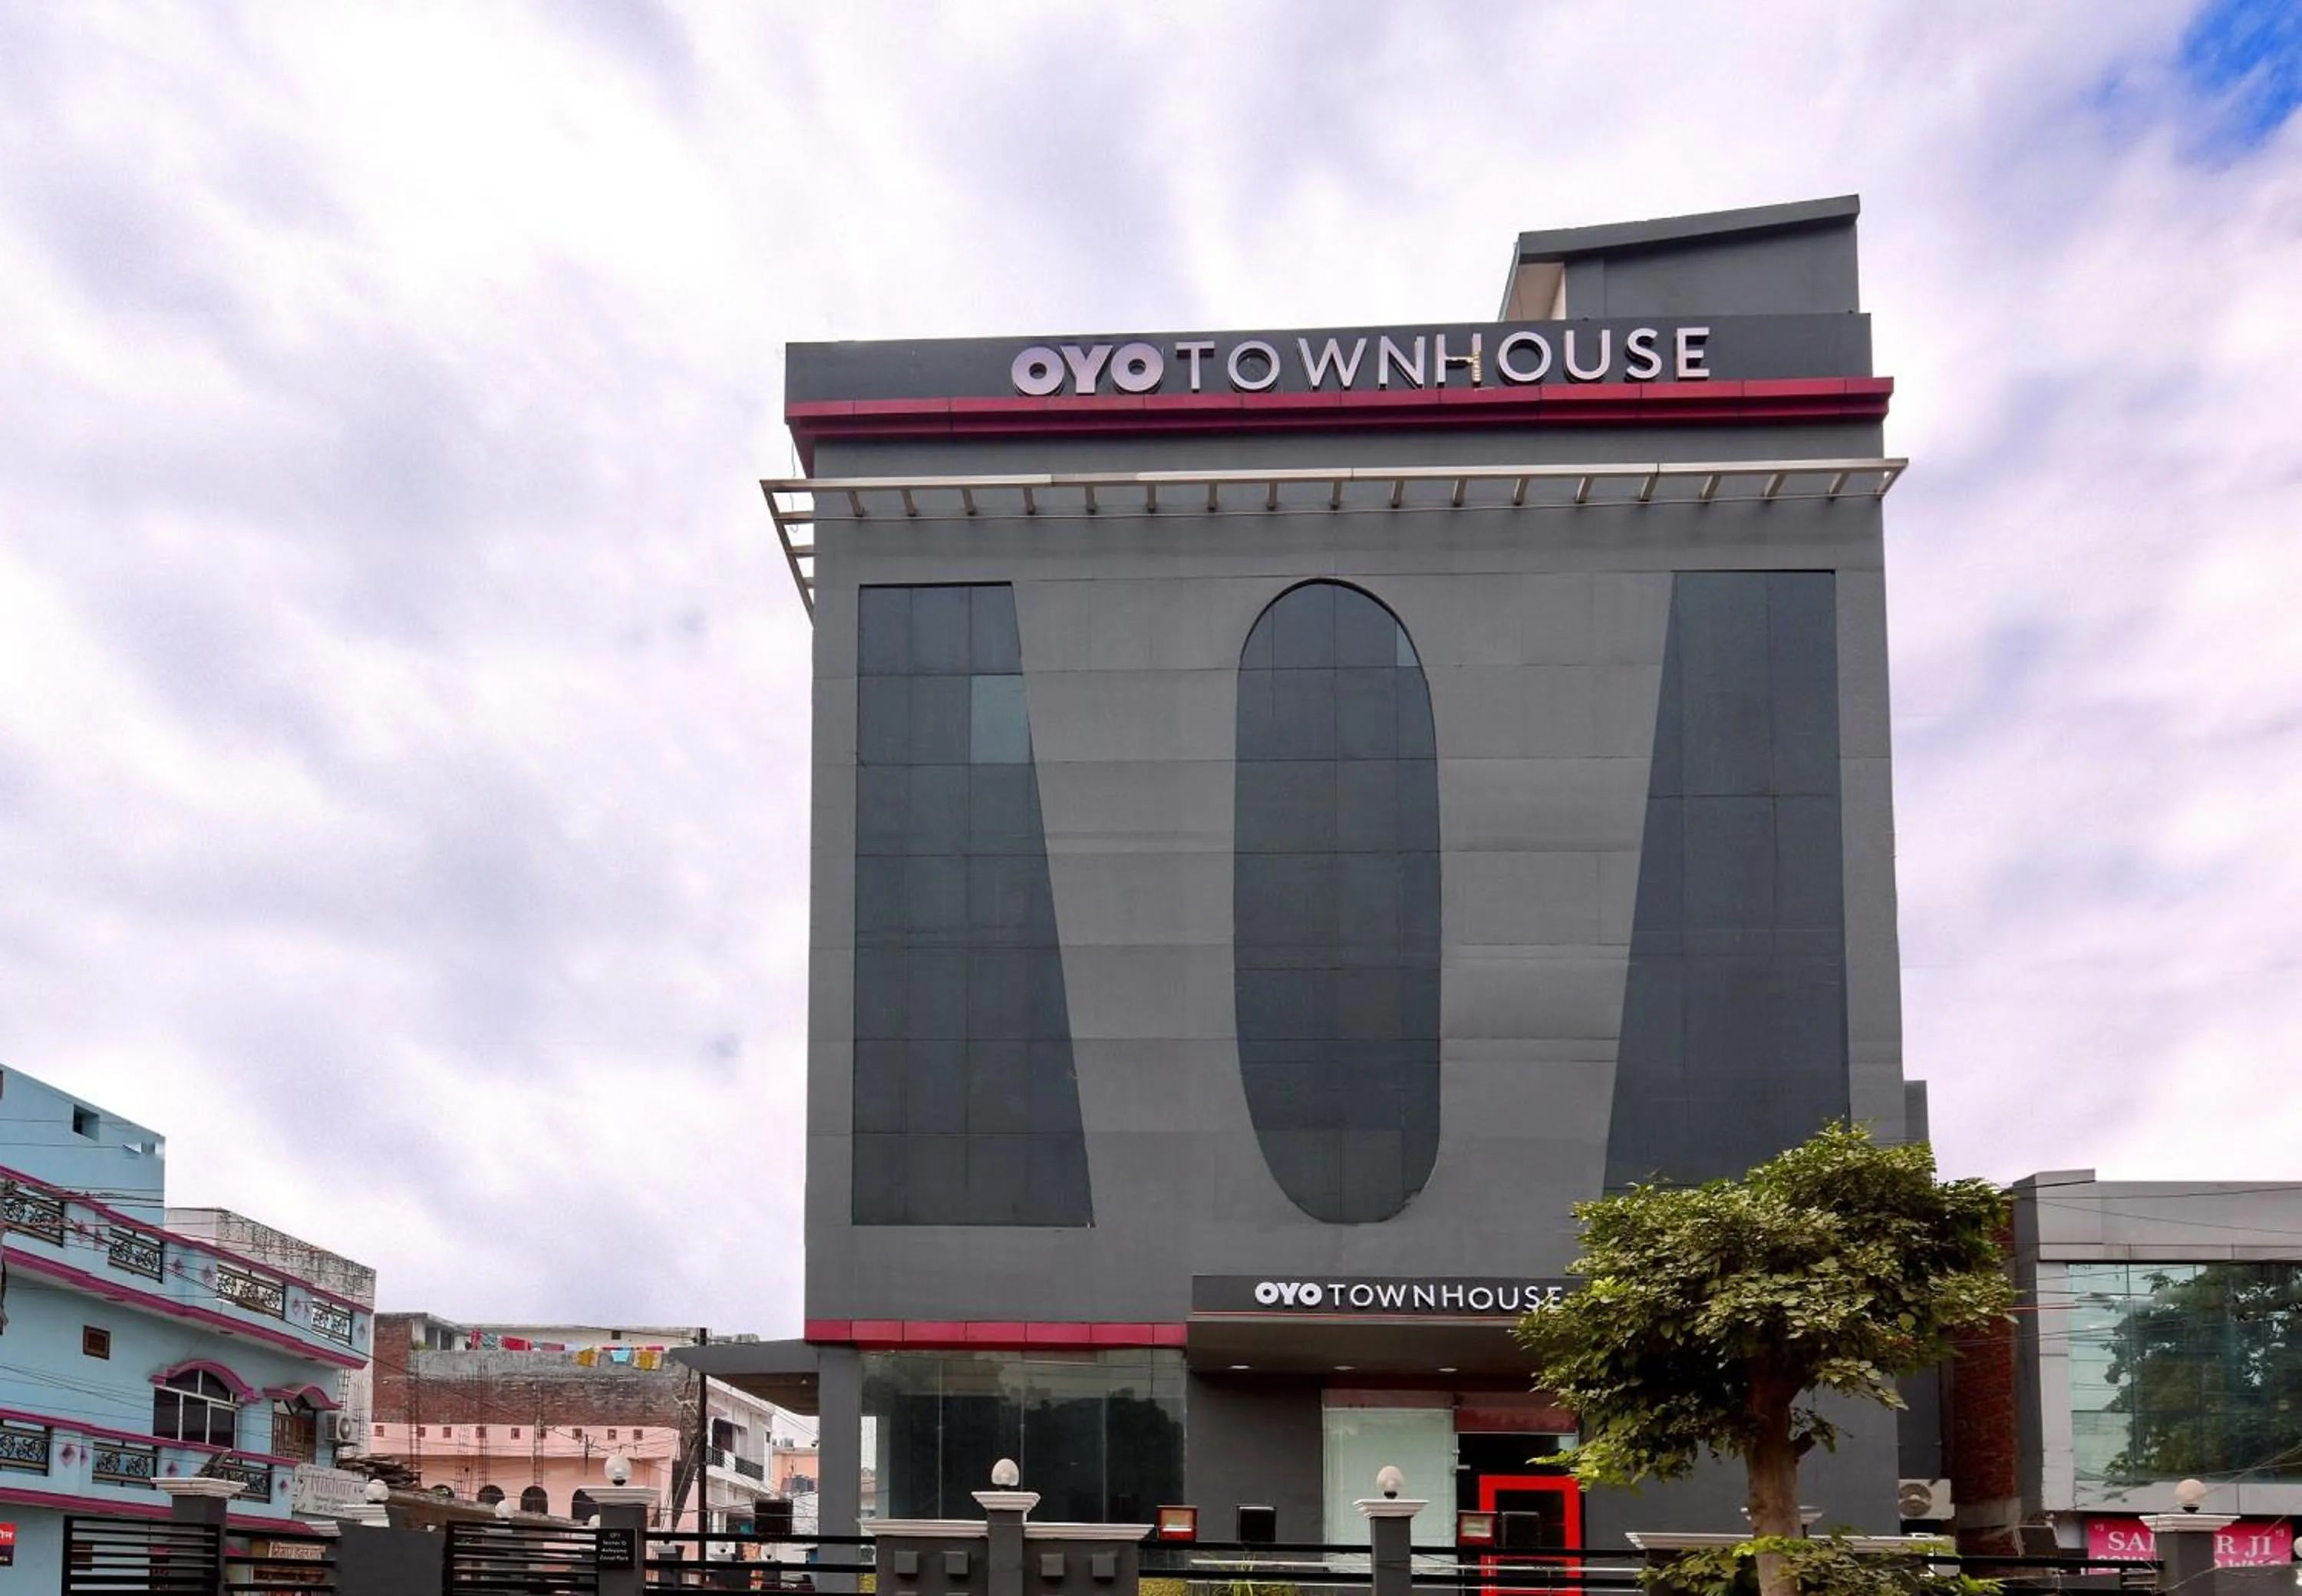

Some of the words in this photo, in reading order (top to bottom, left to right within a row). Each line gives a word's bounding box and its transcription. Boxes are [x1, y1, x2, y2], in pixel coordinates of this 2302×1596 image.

[1011, 341, 1164, 395] OYO
[1175, 327, 1710, 392] TOWNHOUSE
[1255, 1281, 1323, 1306] OYO
[1327, 1284, 1563, 1311] TOWNHOUSE
[2244, 1535, 2272, 1559] JI
